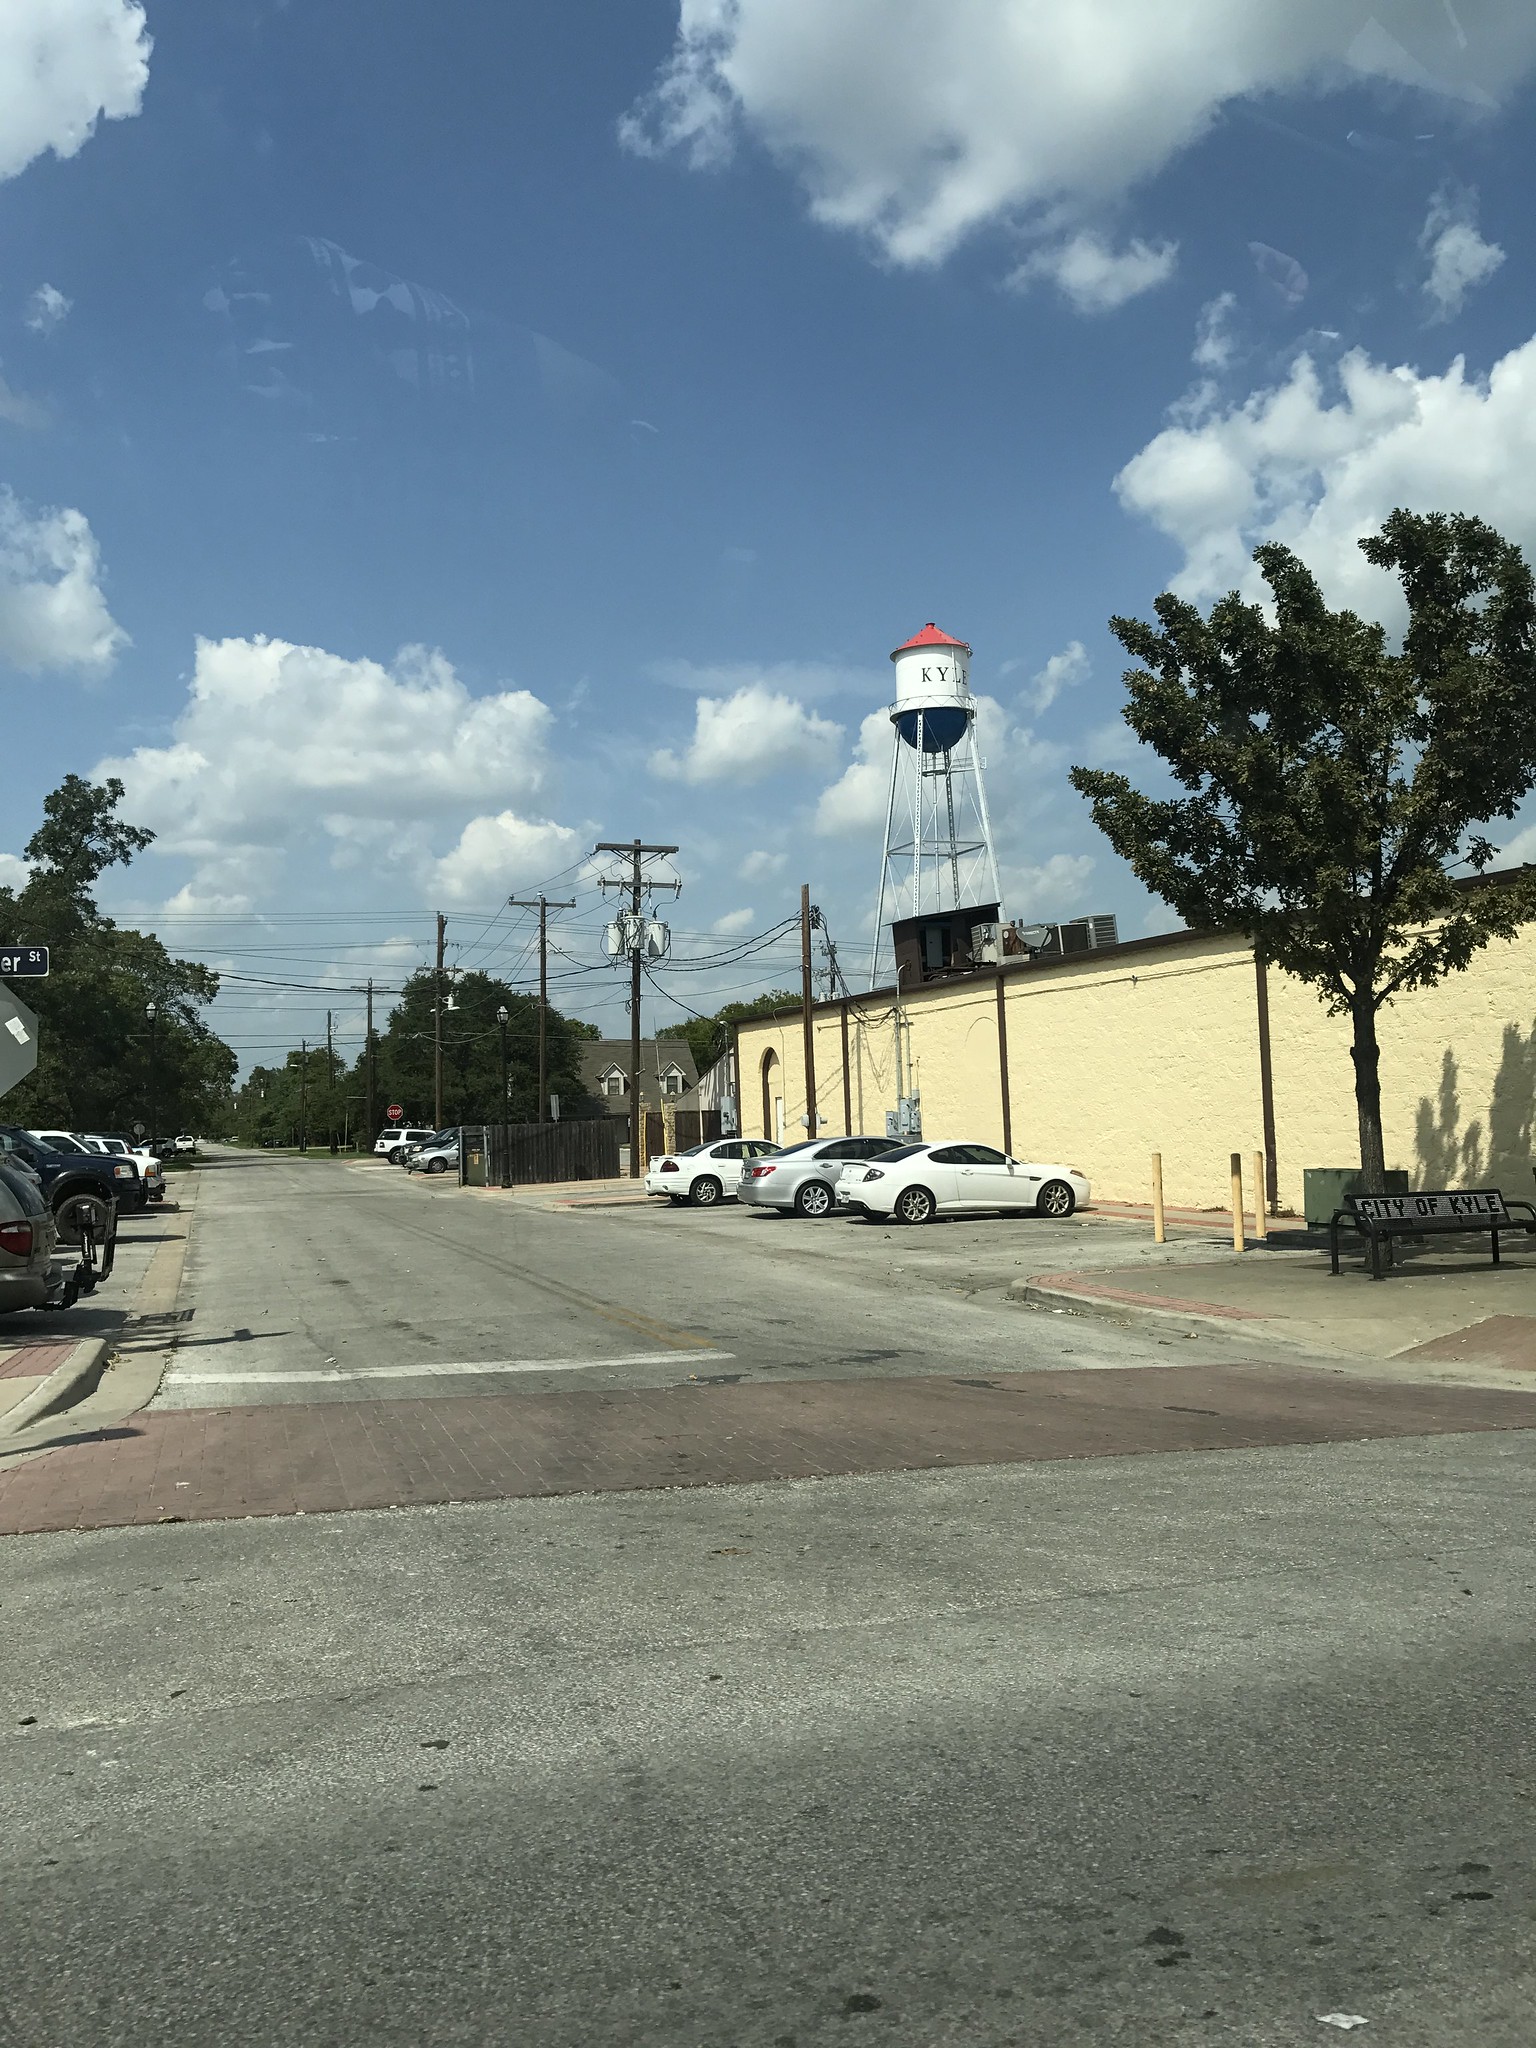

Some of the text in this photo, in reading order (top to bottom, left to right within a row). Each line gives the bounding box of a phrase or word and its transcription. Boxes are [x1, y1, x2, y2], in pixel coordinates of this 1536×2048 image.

[28, 950, 41, 962] St
[1361, 1194, 1500, 1219] CITY OF KYLE
